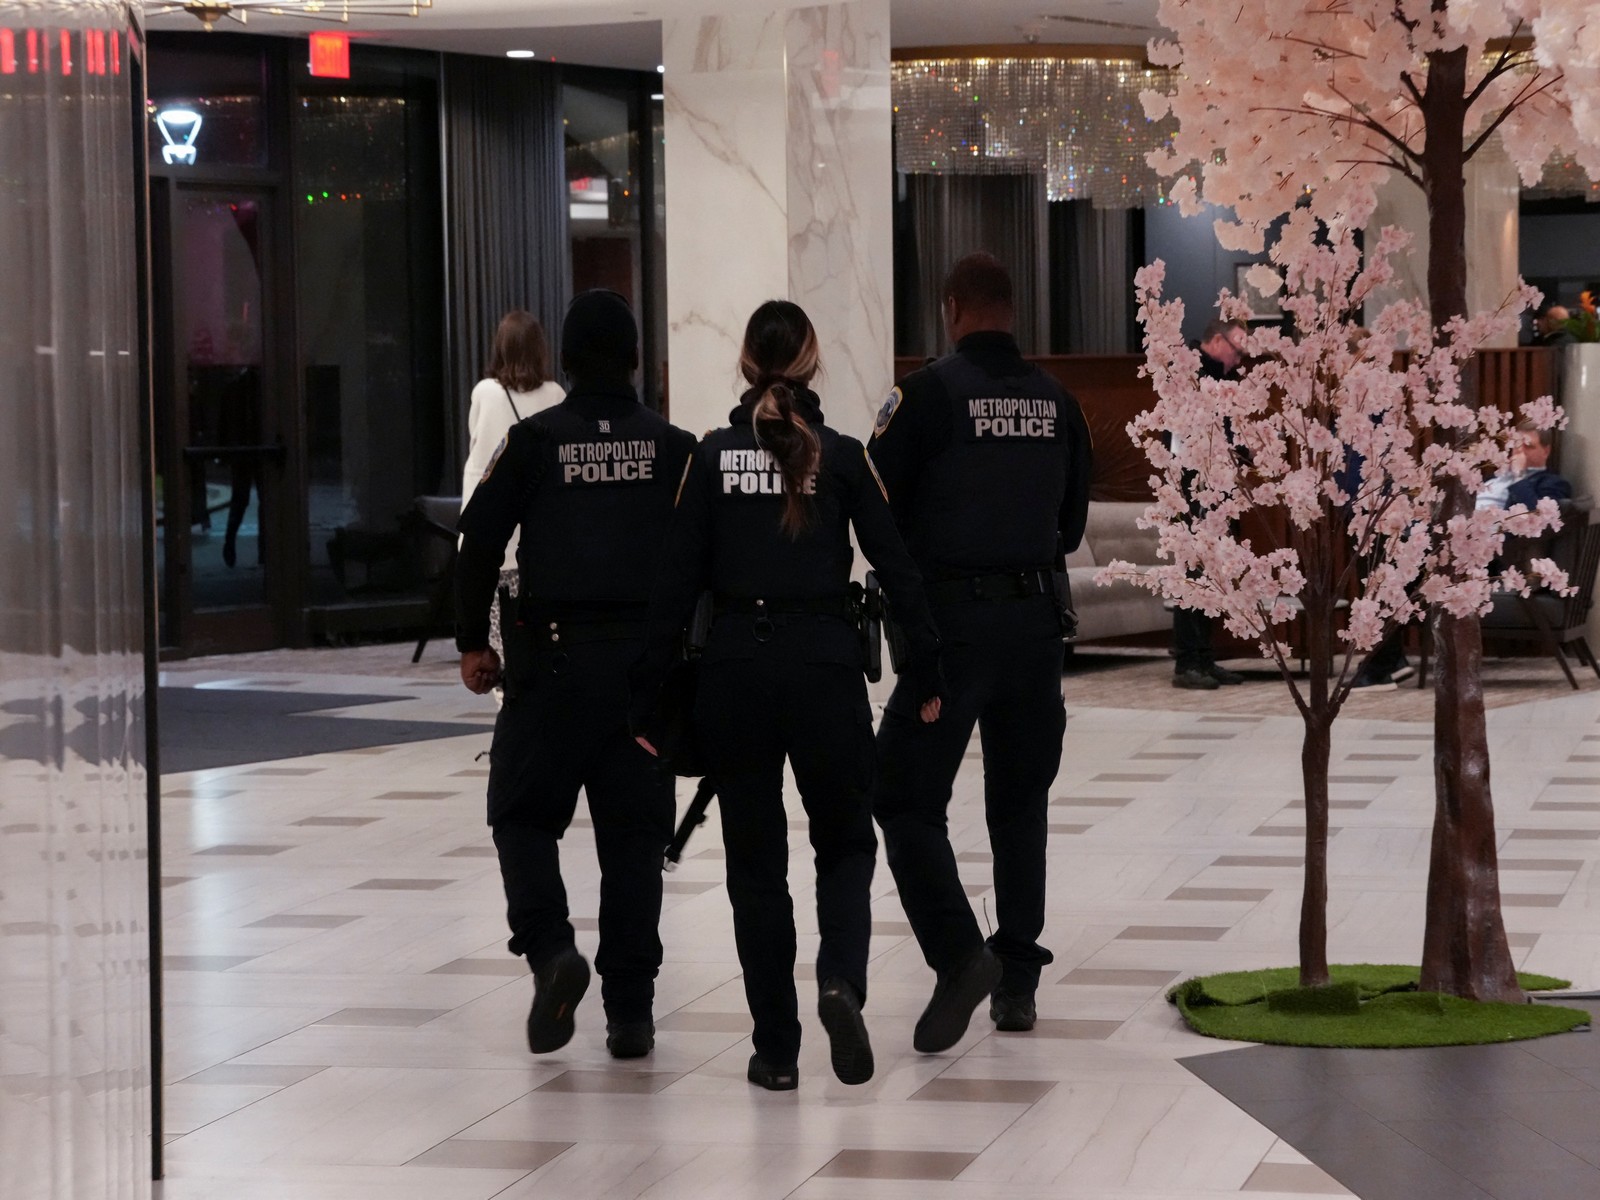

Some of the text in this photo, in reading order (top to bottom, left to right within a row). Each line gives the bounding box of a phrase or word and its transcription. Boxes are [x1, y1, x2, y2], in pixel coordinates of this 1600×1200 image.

[968, 398, 1057, 418] METROPOLITAN
[975, 418, 1055, 437] POLICE
[558, 440, 656, 463] METROPOLITAN
[720, 449, 783, 471] METROP
[564, 460, 653, 483] POLICE
[723, 472, 816, 494] POLIE
